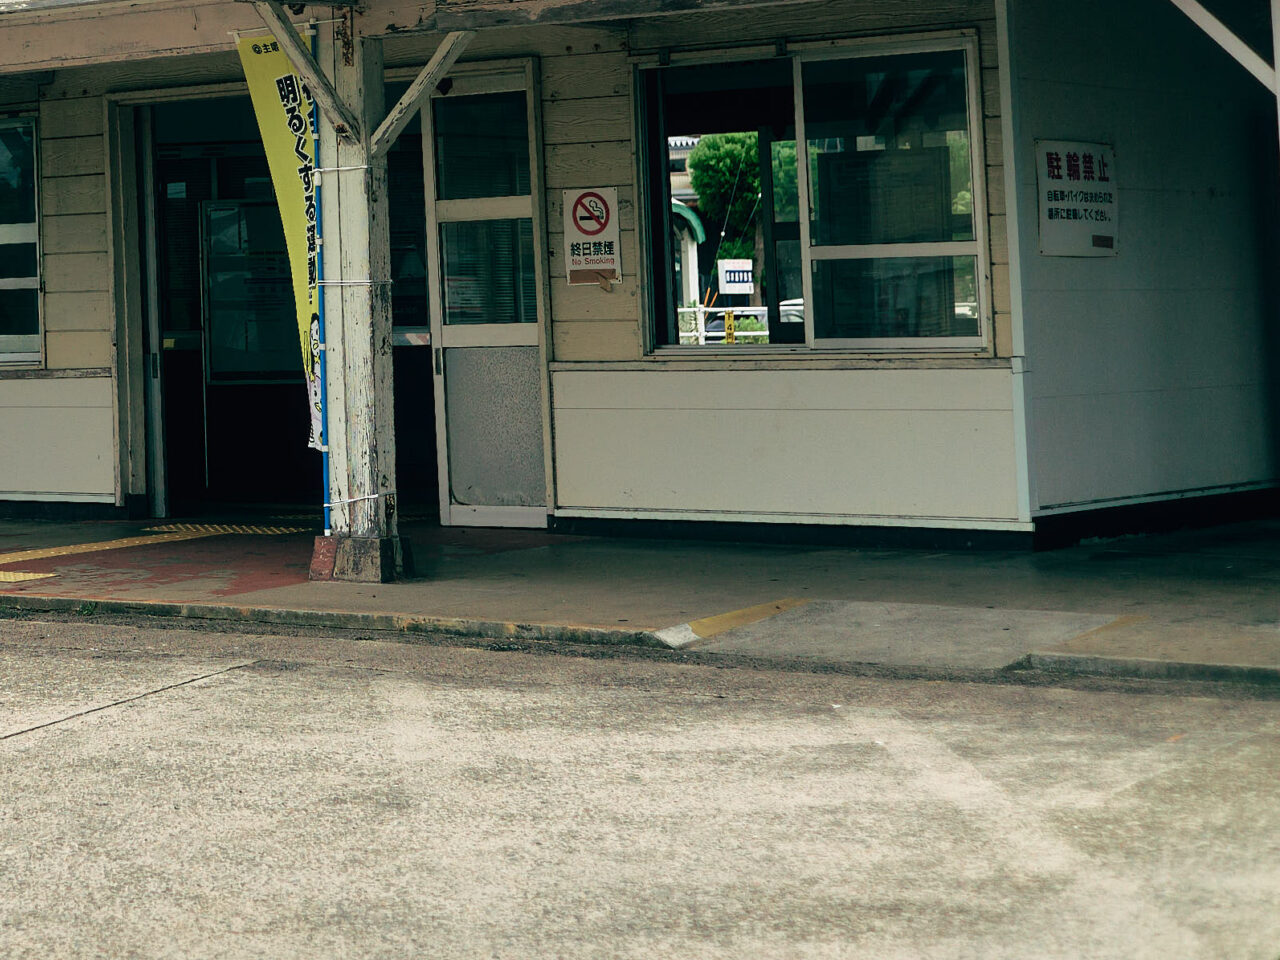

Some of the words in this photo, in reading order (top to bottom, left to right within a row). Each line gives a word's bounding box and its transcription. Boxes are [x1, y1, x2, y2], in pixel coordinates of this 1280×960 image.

[1046, 151, 1109, 182] 駐輪禁止
[570, 241, 614, 257] 終日禁煙
[572, 258, 581, 266] No
[584, 257, 615, 266] Smoking
